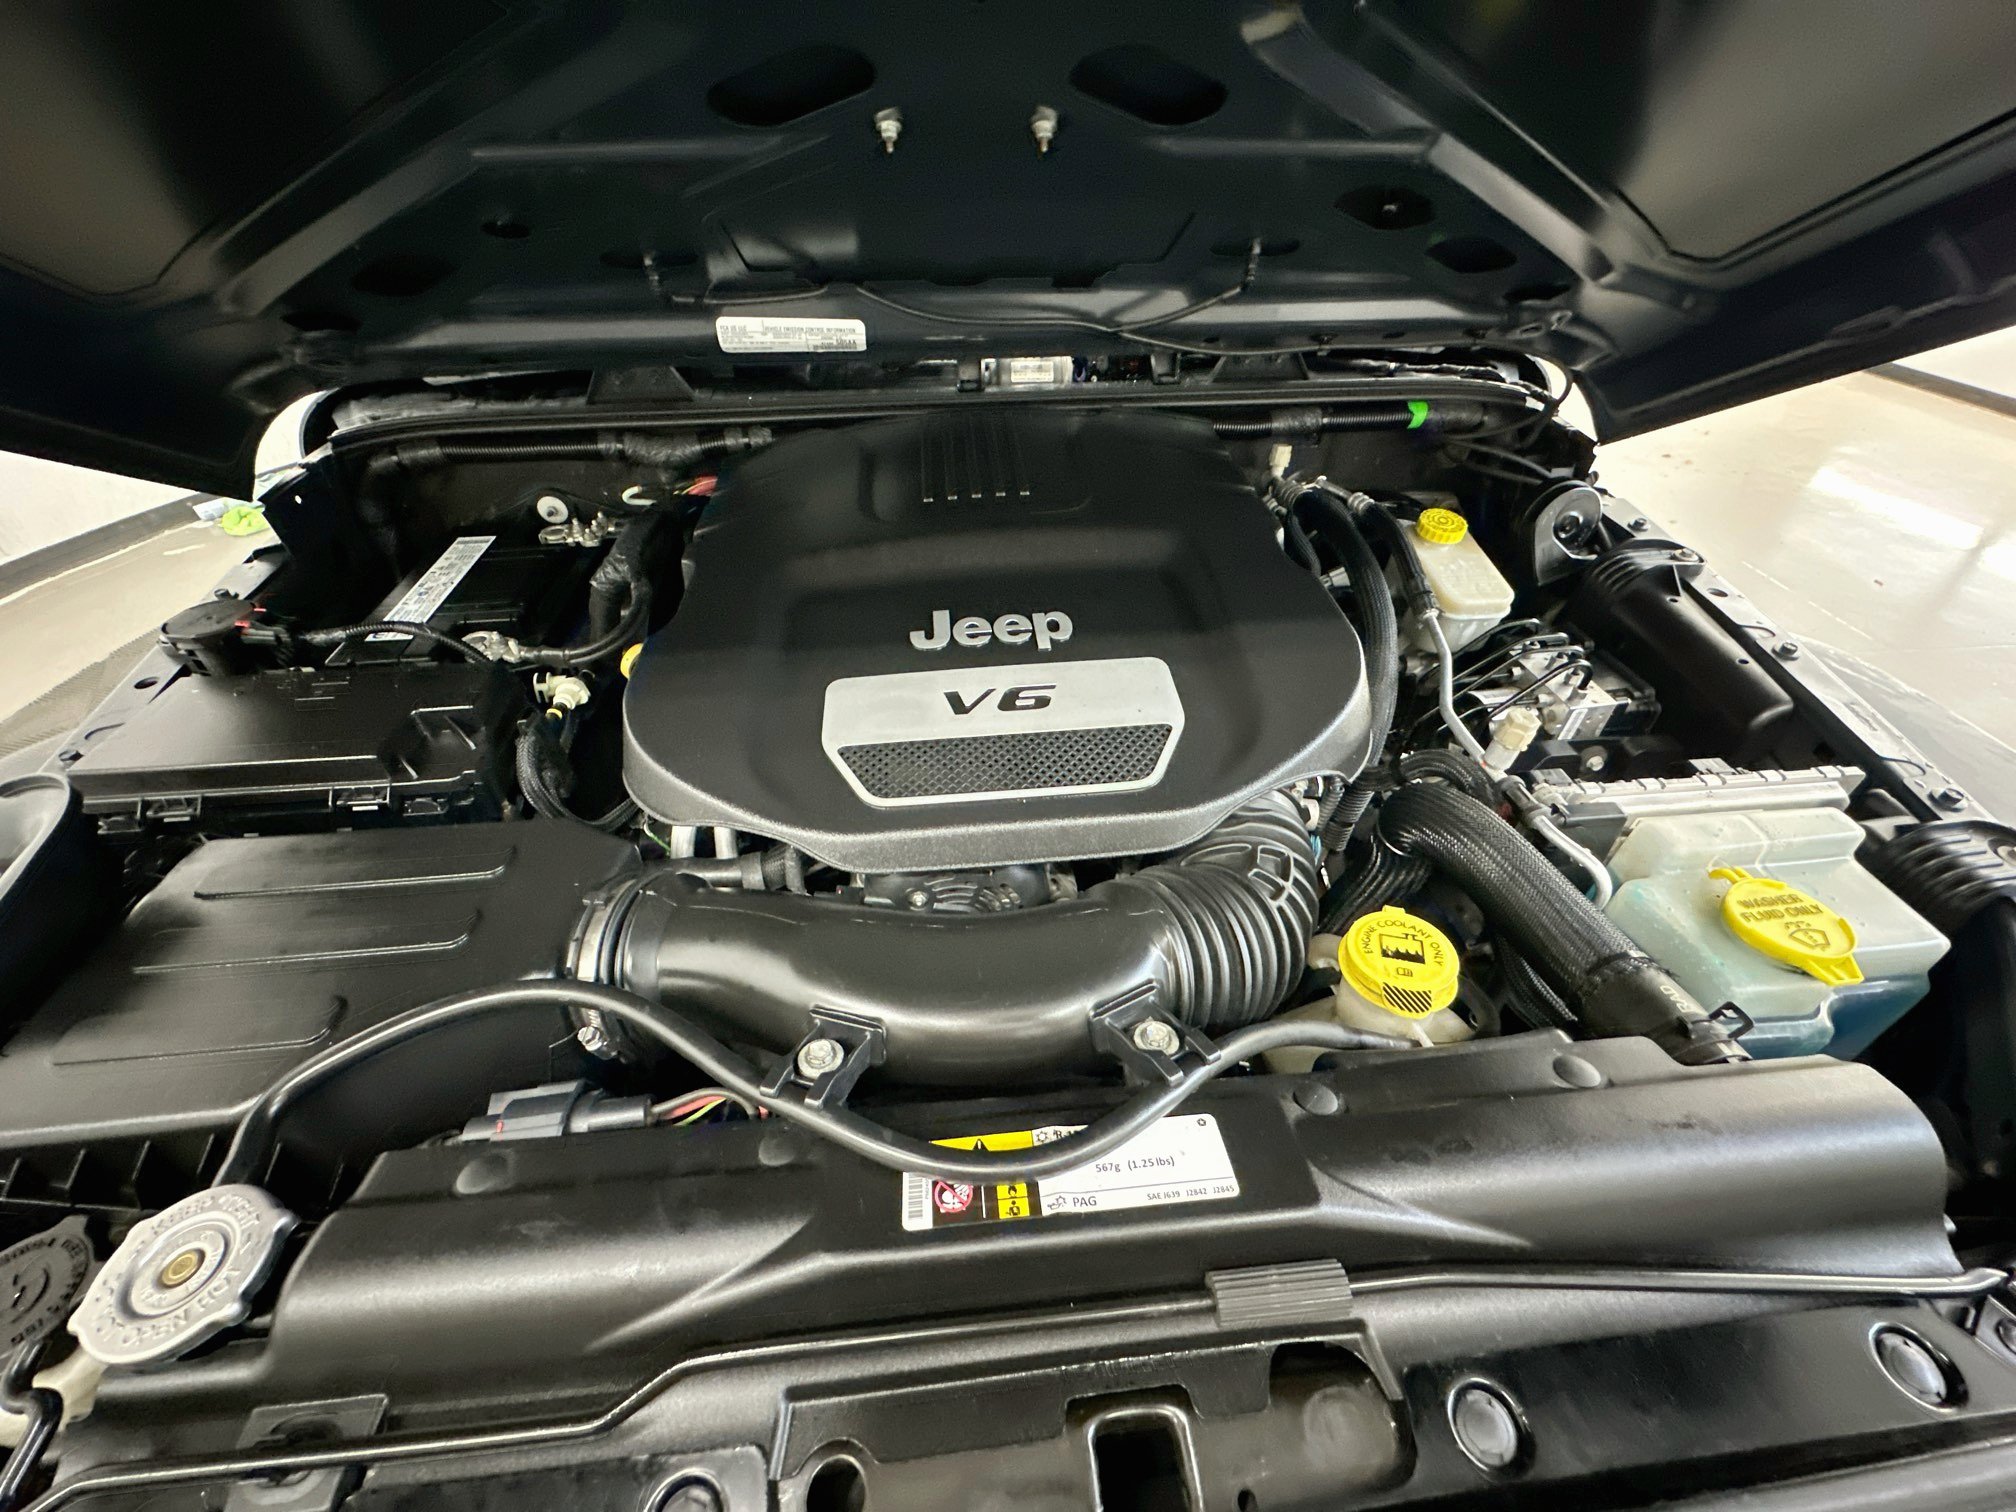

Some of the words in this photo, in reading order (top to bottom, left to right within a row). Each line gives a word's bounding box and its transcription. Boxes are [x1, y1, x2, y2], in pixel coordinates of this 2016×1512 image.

[909, 609, 1074, 652] Jeep
[943, 684, 1057, 716] V6
[1737, 894, 1804, 909] WASHER
[1740, 908, 1785, 922] FLUID
[1784, 903, 1824, 917] ONLY
[1361, 924, 1377, 955] ENGINE
[1376, 919, 1433, 940] COOLANT
[1430, 941, 1444, 967] ONLY
[1095, 1162, 1121, 1174] 567g
[1128, 1158, 1155, 1172] (1.25
[1156, 1156, 1175, 1169] lbs)
[1073, 1196, 1097, 1208] PAG
[1147, 1193, 1162, 1201] SAE
[1163, 1190, 1181, 1200] J639
[1186, 1188, 1207, 1197] J2842
[1213, 1185, 1235, 1194] J2845
[151, 1194, 215, 1237] KEEP
[217, 1192, 262, 1227] TIGHT
[121, 1306, 191, 1347] OPEN
[198, 1266, 242, 1310] HOT
